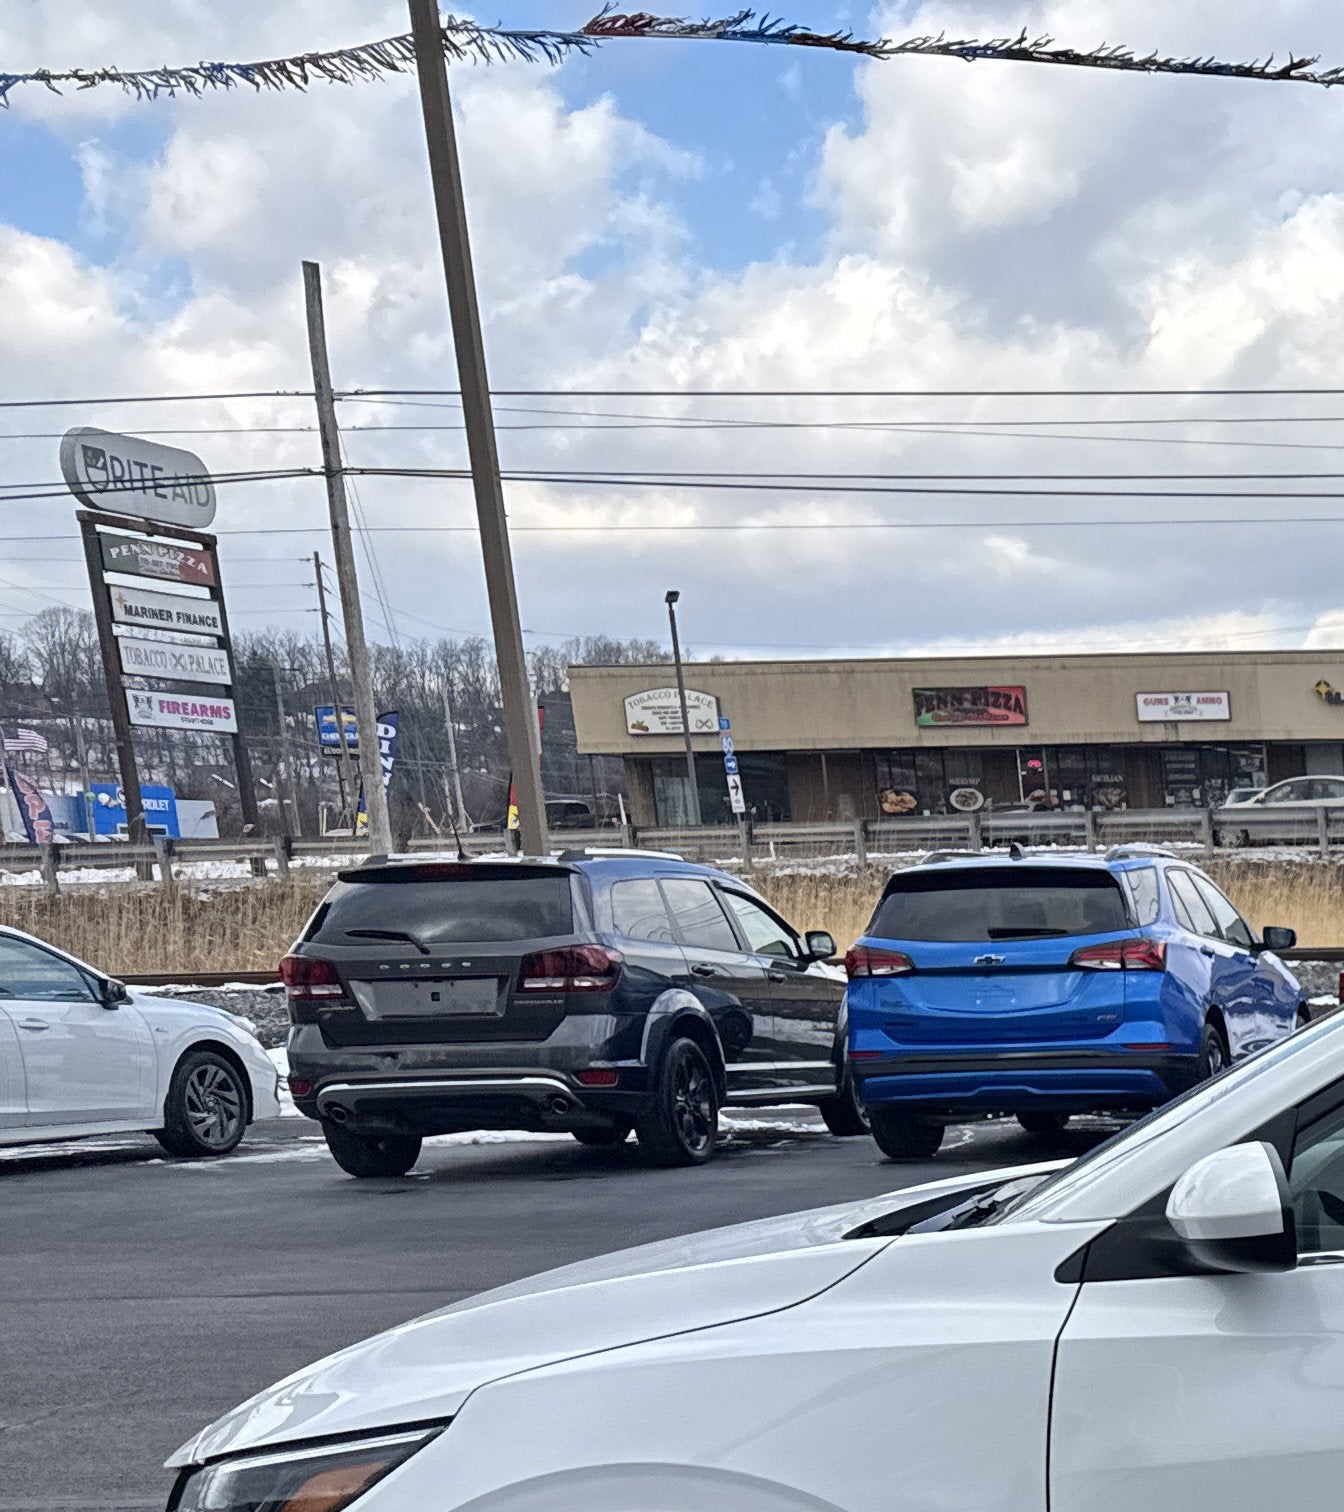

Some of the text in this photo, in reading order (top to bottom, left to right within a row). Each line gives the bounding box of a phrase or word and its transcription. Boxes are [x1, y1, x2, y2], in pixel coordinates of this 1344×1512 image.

[109, 455, 211, 508] RITE AID
[109, 544, 153, 559] PENN
[157, 546, 209, 575] PIZZA
[123, 604, 219, 629] MARINER FINANCE
[122, 646, 227, 676] TOBACCO PALACE
[158, 700, 232, 721] FIREARMS
[627, 691, 671, 709] TOBACCO
[969, 689, 1024, 715] PIZZA
[379, 961, 472, 970] DODGE
